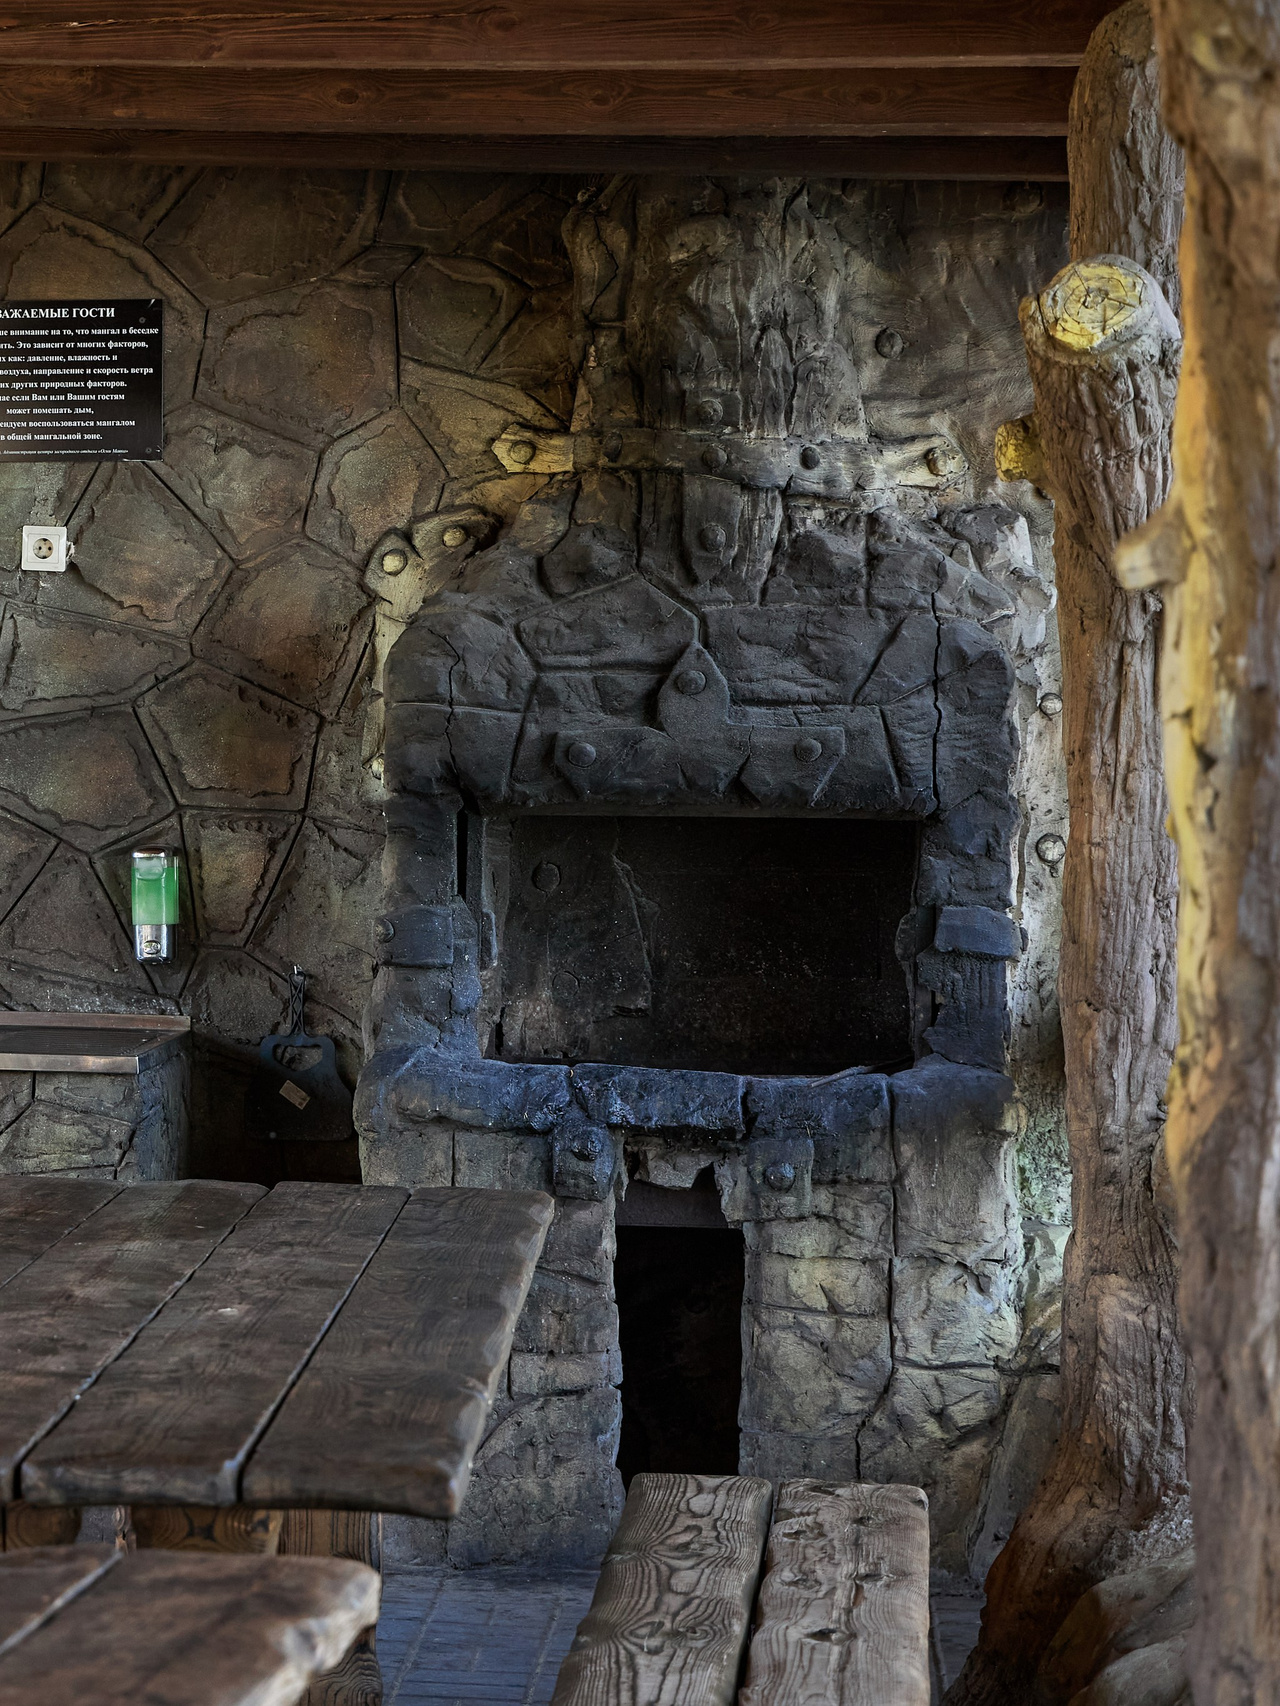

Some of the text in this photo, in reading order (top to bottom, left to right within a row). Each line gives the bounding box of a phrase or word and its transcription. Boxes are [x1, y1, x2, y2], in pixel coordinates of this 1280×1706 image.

[72, 307, 116, 319] ГОСТИ
[61, 328, 74, 337] то,
[128, 326, 160, 335] беседке
[15, 340, 32, 349] Это
[76, 341, 106, 349] многих
[107, 339, 149, 350] факторов,
[7, 355, 26, 363] как:
[26, 355, 67, 363] давление,
[67, 354, 111, 362] влажность
[0, 368, 32, 377] воздуха,
[32, 368, 85, 377] направление
[92, 367, 130, 376] скорость
[130, 367, 154, 376] ветра
[10, 381, 39, 390] других
[39, 381, 85, 390] природных
[86, 379, 128, 390] факторов.
[31, 393, 48, 401] Вам
[66, 392, 96, 401] Вашим
[97, 393, 125, 401] гостям
[73, 407, 95, 415] дым,
[28, 420, 95, 428] воспользоваться
[6, 432, 32, 441] общей
[33, 432, 82, 441] мангальной
